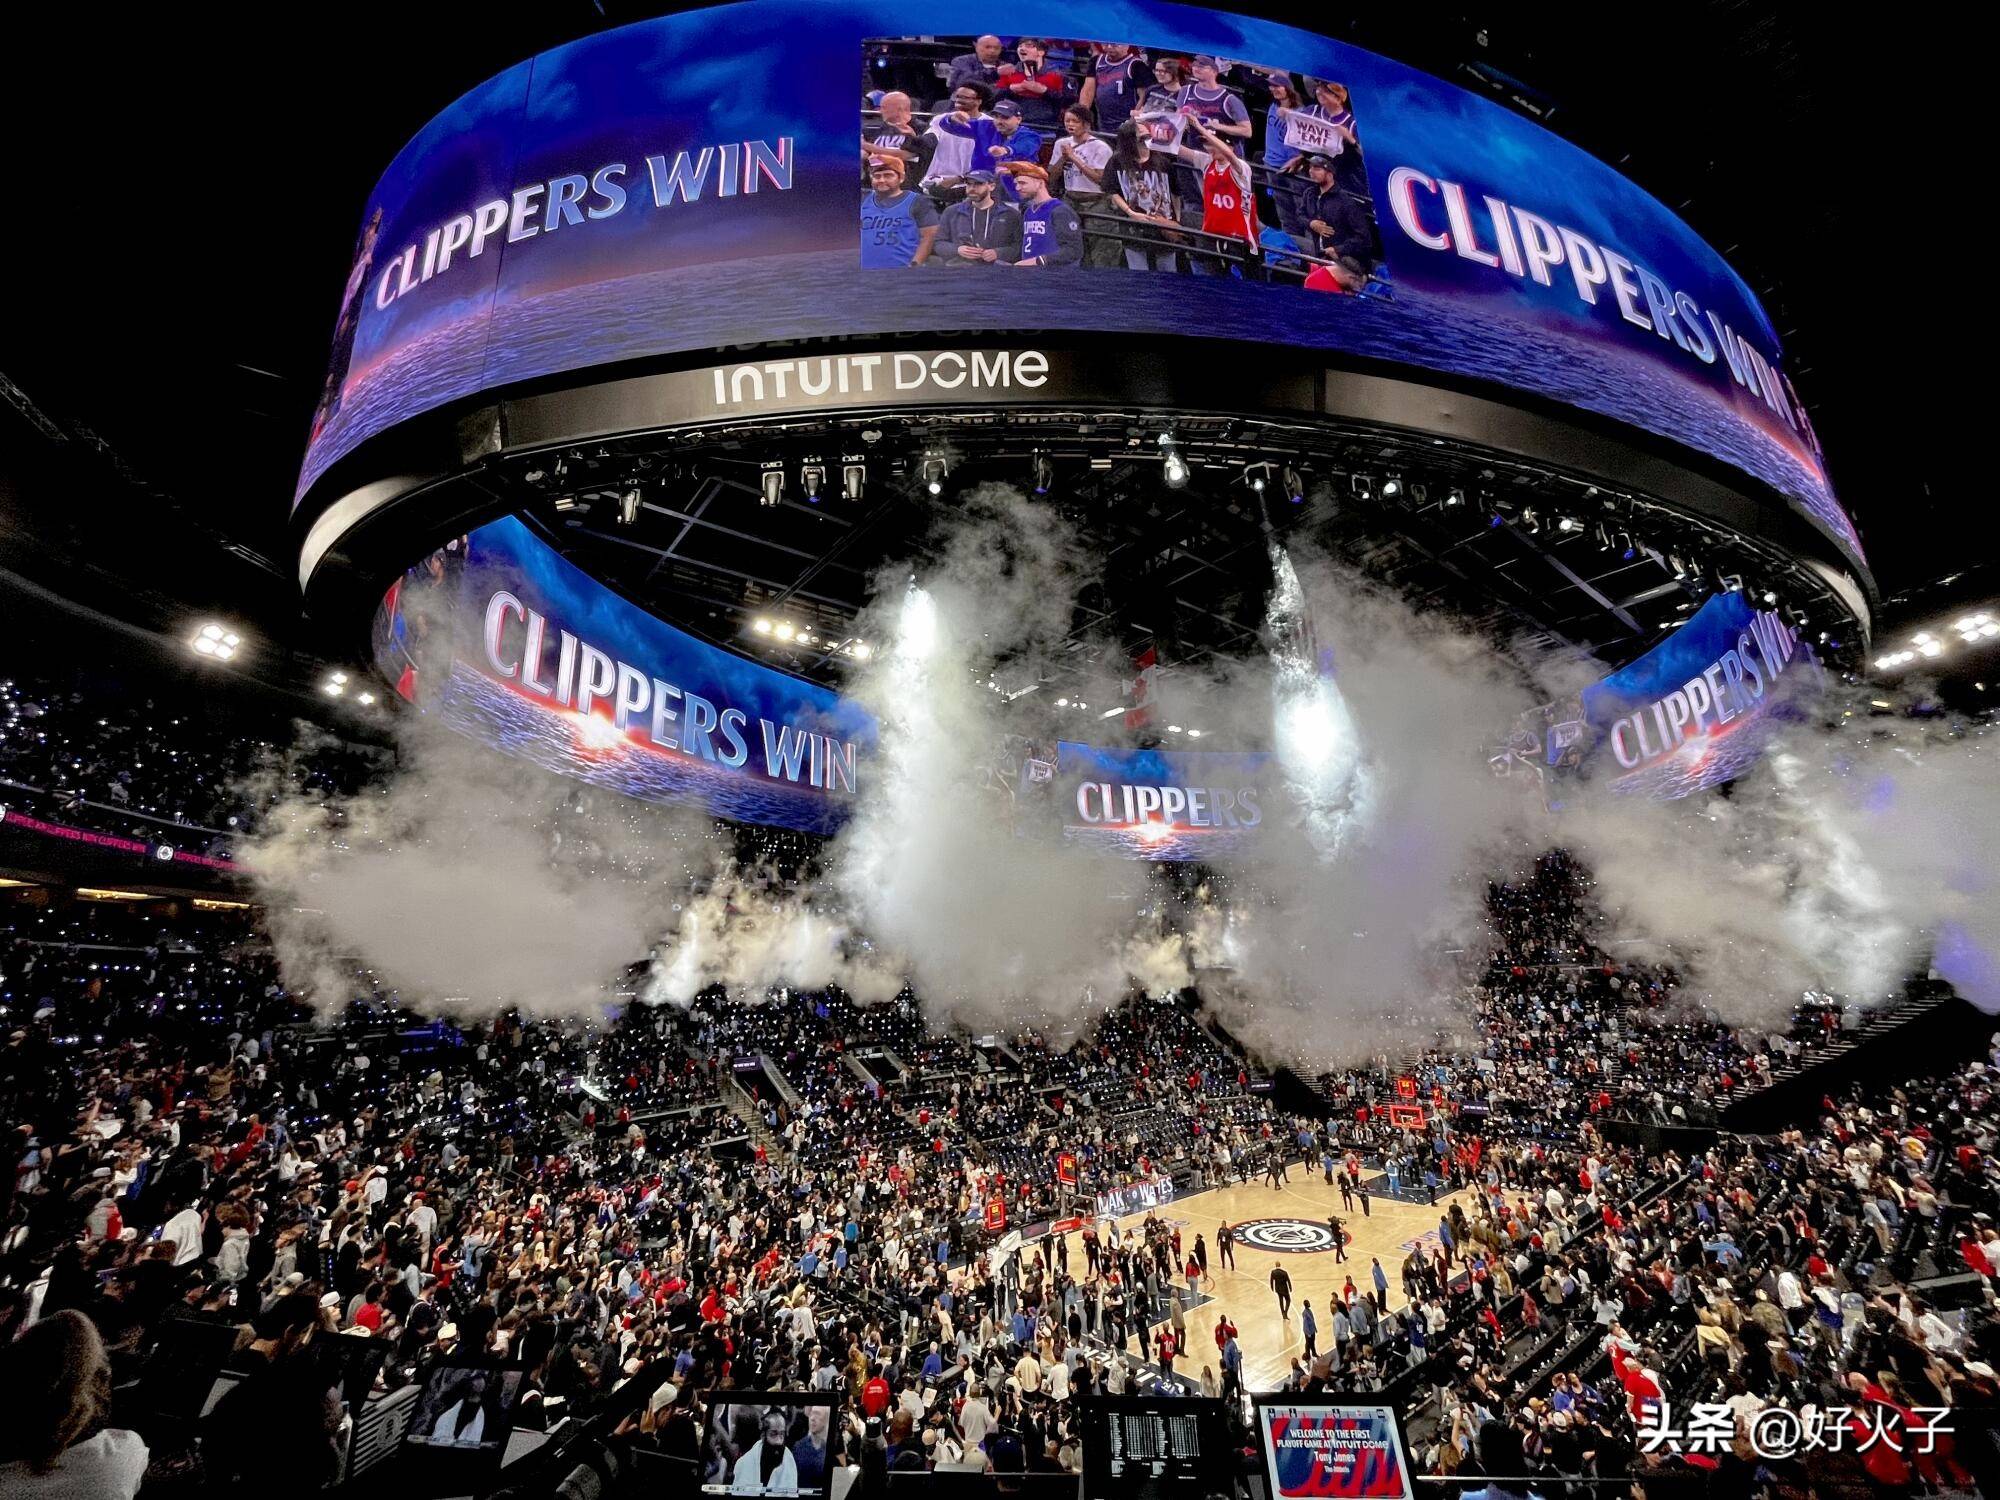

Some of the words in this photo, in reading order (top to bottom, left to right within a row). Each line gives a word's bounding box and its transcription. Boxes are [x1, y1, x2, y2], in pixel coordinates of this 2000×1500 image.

[1295, 120, 1331, 138] WAVE
[1212, 193, 1235, 210] 40
[376, 163, 627, 311] CLIPPERS
[646, 137, 795, 208] WIN
[861, 216, 902, 231] Clips
[873, 231, 899, 246] 55
[1024, 237, 1033, 253] 2
[1388, 166, 1716, 364] CLIPPERS
[1706, 310, 1798, 431] WIN
[714, 355, 881, 405] INTUIT
[484, 590, 748, 769] CLIPPERS
[760, 718, 857, 795] WIN
[1611, 633, 1765, 769] CLIPPERS
[1077, 781, 1262, 827] CLIPPERS
[1164, 1340, 1174, 1353] 10
[755, 1361, 762, 1374] 2
[1290, 1429, 1324, 1438] WELCOME
[1325, 1429, 1335, 1438] TO
[1335, 1430, 1350, 1438] THE
[1350, 1430, 1370, 1439] FIRST
[1277, 1440, 1303, 1448] PLAYOFF
[1304, 1440, 1323, 1448] GAME
[1324, 1440, 1332, 1448] AT
[1314, 1451, 1332, 1463] Tony
[1334, 1452, 1355, 1462] Jones
